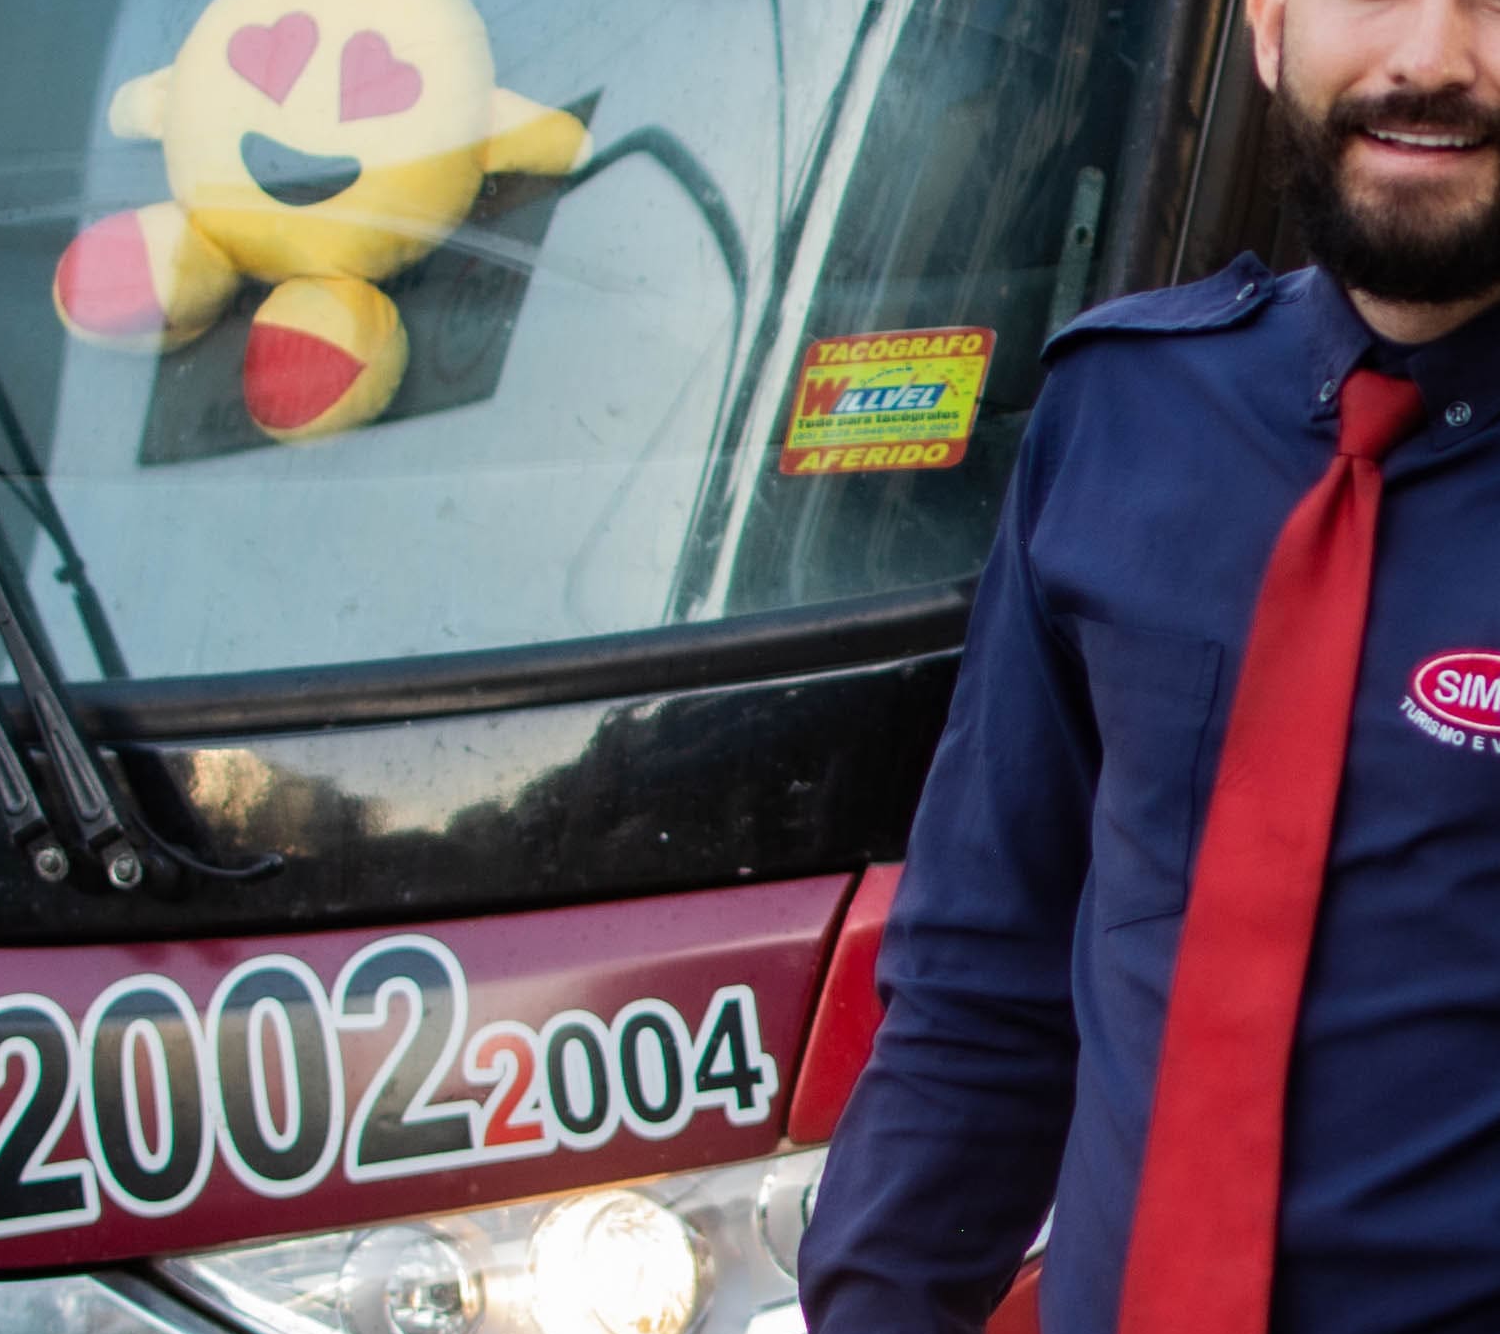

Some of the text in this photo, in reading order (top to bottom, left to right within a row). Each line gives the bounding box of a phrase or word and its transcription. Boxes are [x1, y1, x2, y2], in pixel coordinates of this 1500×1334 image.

[817, 333, 984, 365] TACÓGRAFO
[801, 376, 937, 417] WILLVEL
[794, 442, 950, 472] AFERIDO
[1399, 695, 1466, 746] TURISMO
[1472, 735, 1486, 751] E
[470, 987, 777, 1149] 2004
